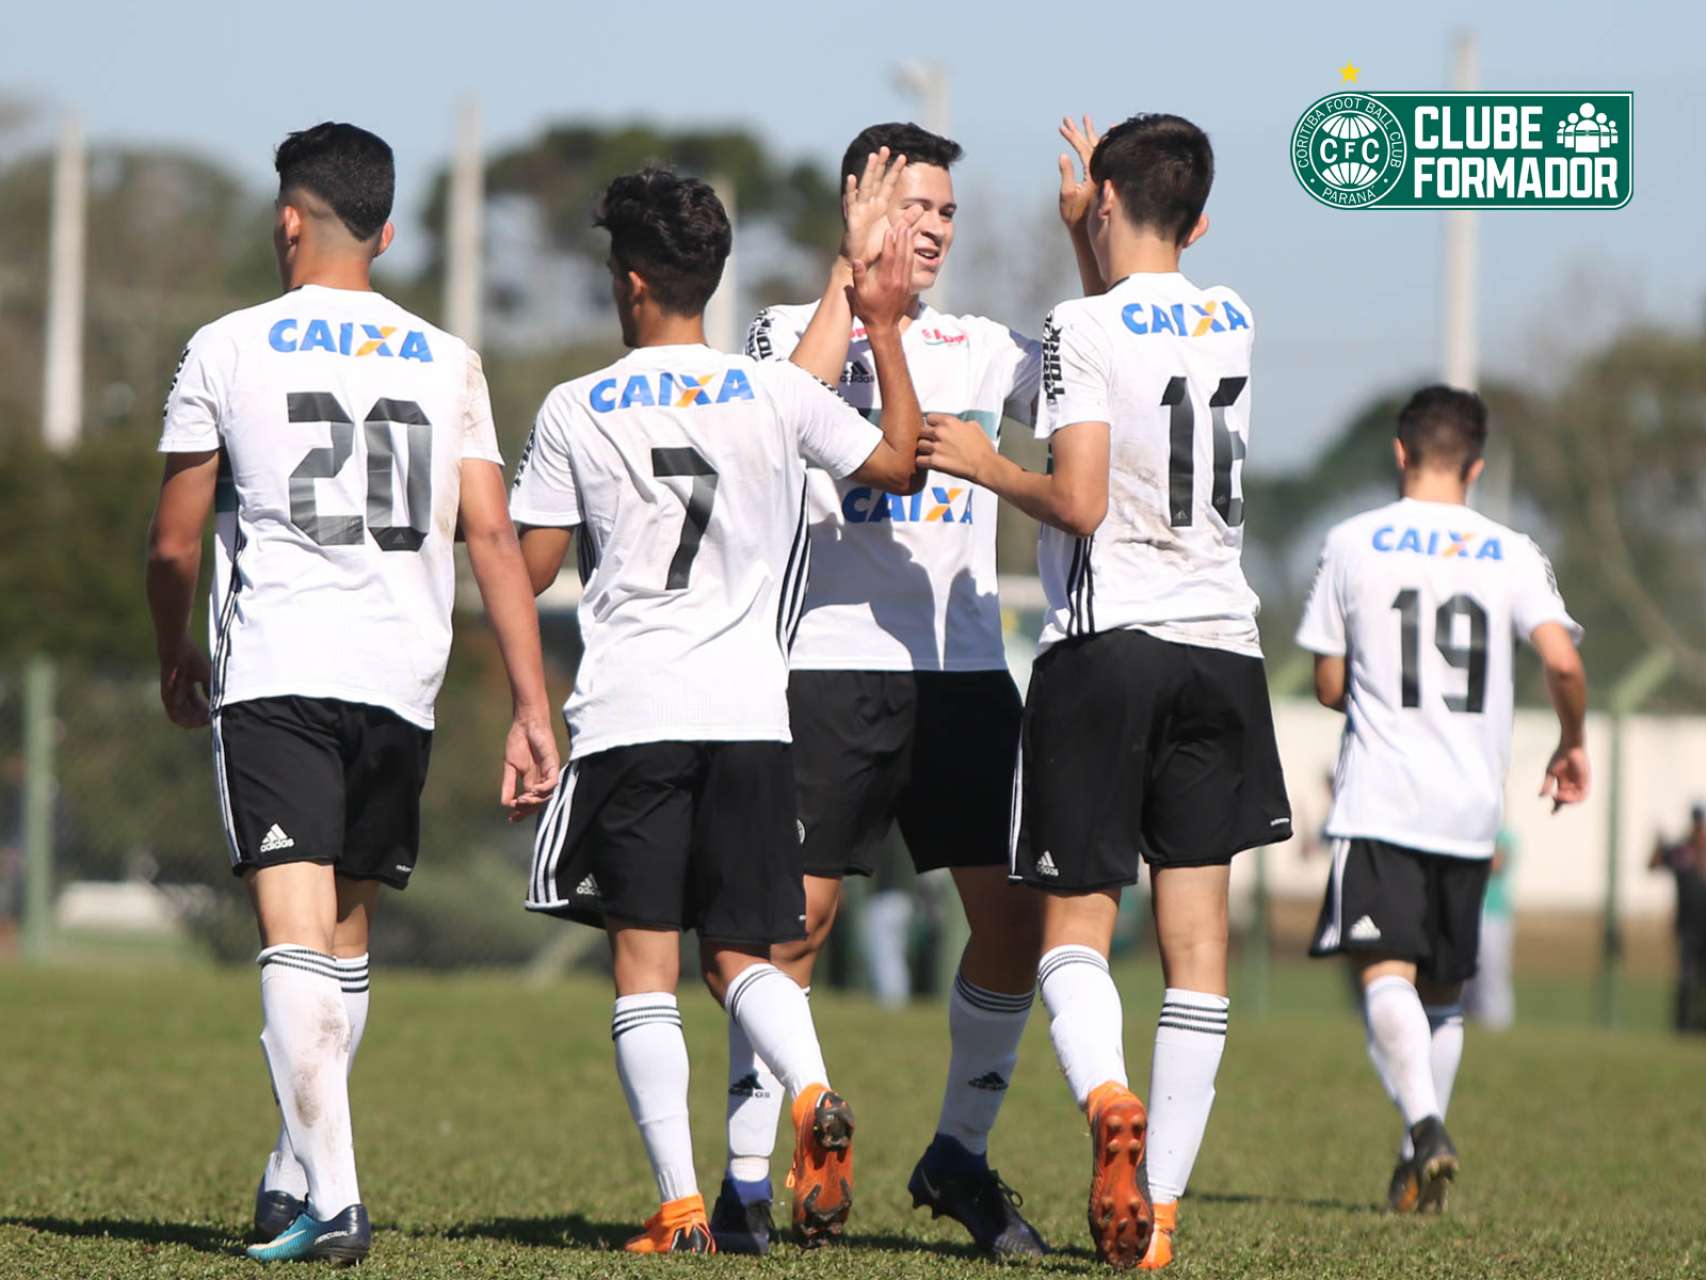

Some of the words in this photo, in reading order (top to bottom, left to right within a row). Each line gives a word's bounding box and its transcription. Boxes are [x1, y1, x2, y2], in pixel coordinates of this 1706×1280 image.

[268, 318, 433, 363] CAIXA
[1121, 301, 1249, 337] CAIXA
[589, 368, 755, 413] CAIXA
[287, 391, 432, 552] 20
[651, 446, 719, 590] 7
[842, 487, 974, 526] CAIXA
[1371, 525, 1504, 561] CAIXA
[1391, 588, 1488, 713] 19
